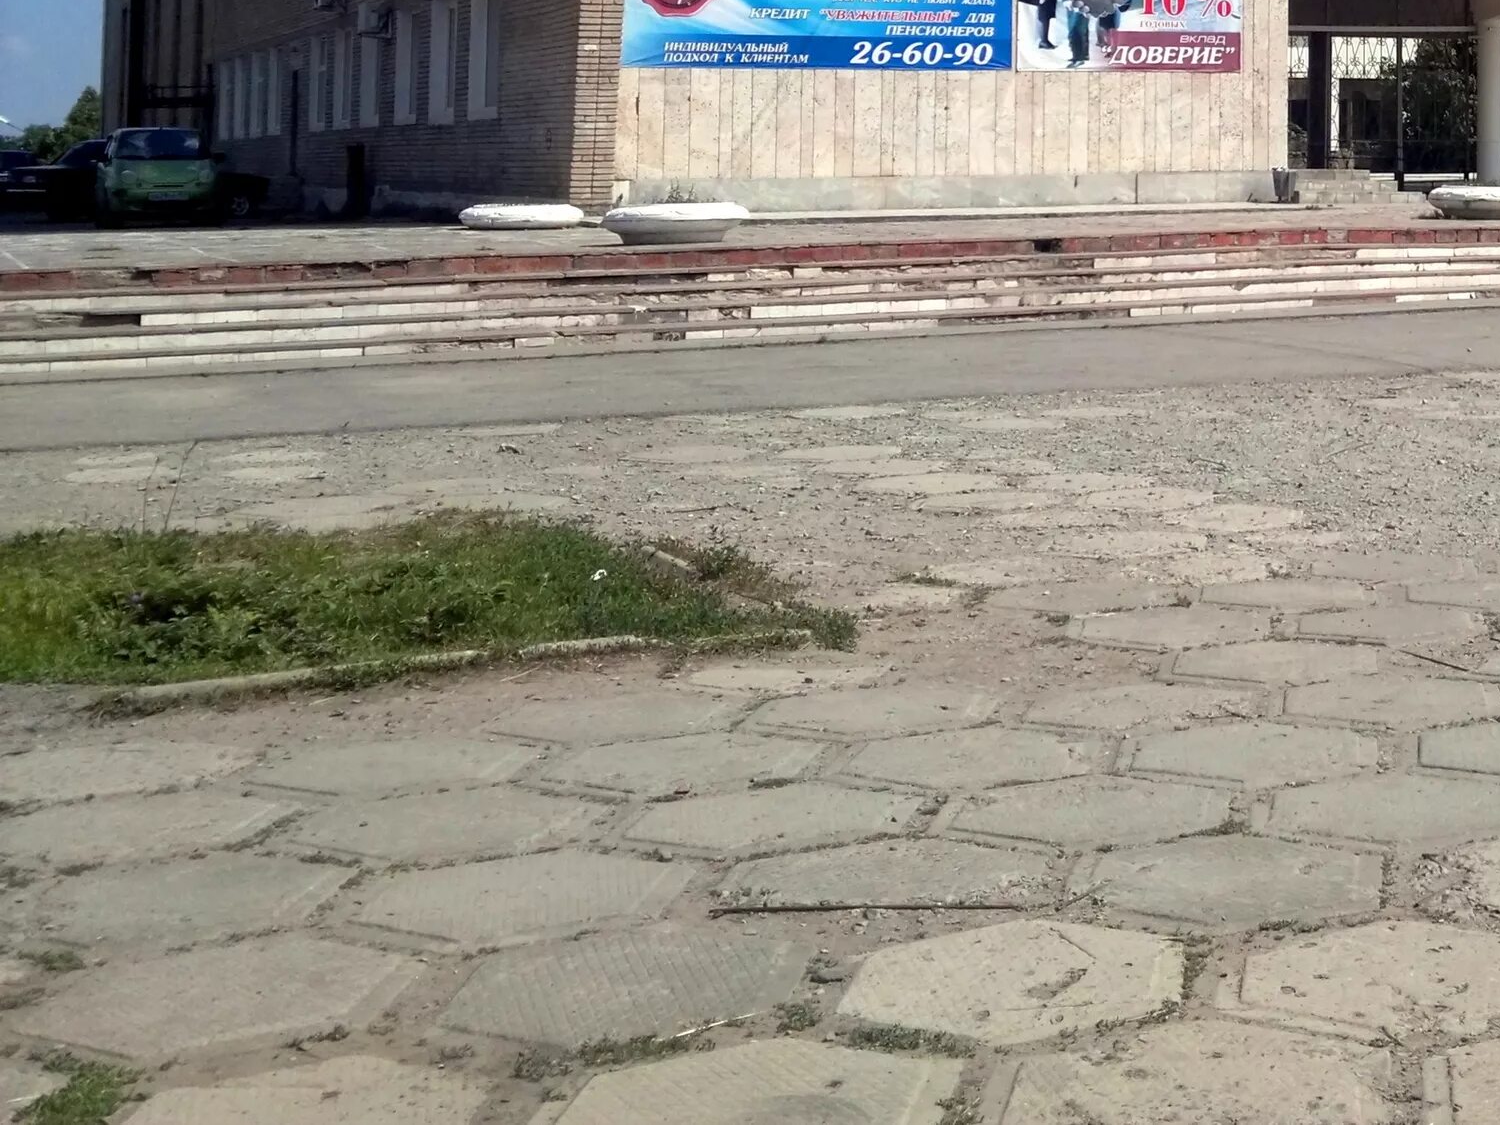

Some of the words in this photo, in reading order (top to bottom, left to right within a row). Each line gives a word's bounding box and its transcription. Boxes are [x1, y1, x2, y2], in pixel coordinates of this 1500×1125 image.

[749, 7, 811, 19] КРЕДИТ
[964, 12, 995, 24] ДЛЯ
[885, 25, 995, 37] ПЕНСИОНЕРОВ
[663, 41, 788, 53] ИНДИВИДУАЛЬНЫЙ
[850, 41, 993, 65] 26-60-90
[663, 53, 719, 63] ПОДХОД
[724, 53, 734, 63] К
[740, 53, 809, 64] КЛИЕНТАМ
